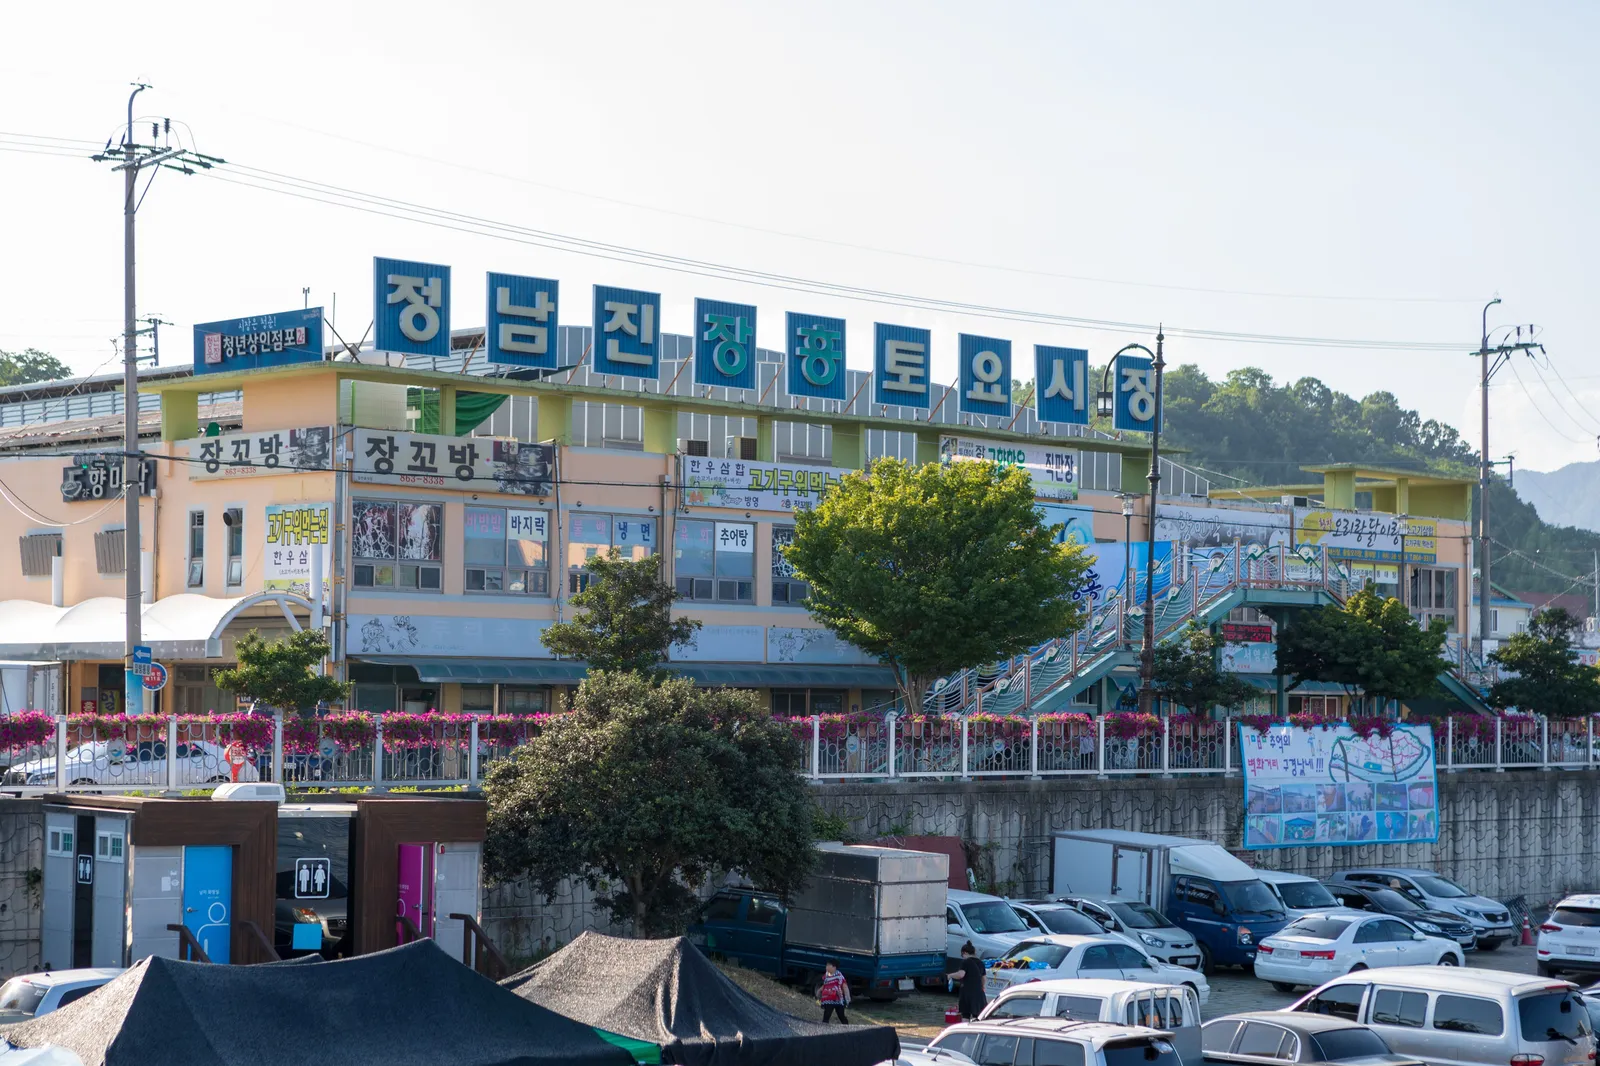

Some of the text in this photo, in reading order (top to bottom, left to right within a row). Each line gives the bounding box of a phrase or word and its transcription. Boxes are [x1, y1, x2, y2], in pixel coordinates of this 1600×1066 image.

[223, 328, 296, 358] 청년상인점포
[200, 434, 283, 473] 장꼬방
[365, 436, 479, 481] 장꼬방
[225, 467, 257, 476] 863-8338
[400, 474, 445, 485] 863-8338
[691, 460, 745, 477] 한우삼합
[748, 468, 844, 501] 고기구워먹는
[267, 508, 329, 546] 고기구워먹는집
[511, 515, 546, 536] 바지락
[720, 528, 748, 547] 추어탕
